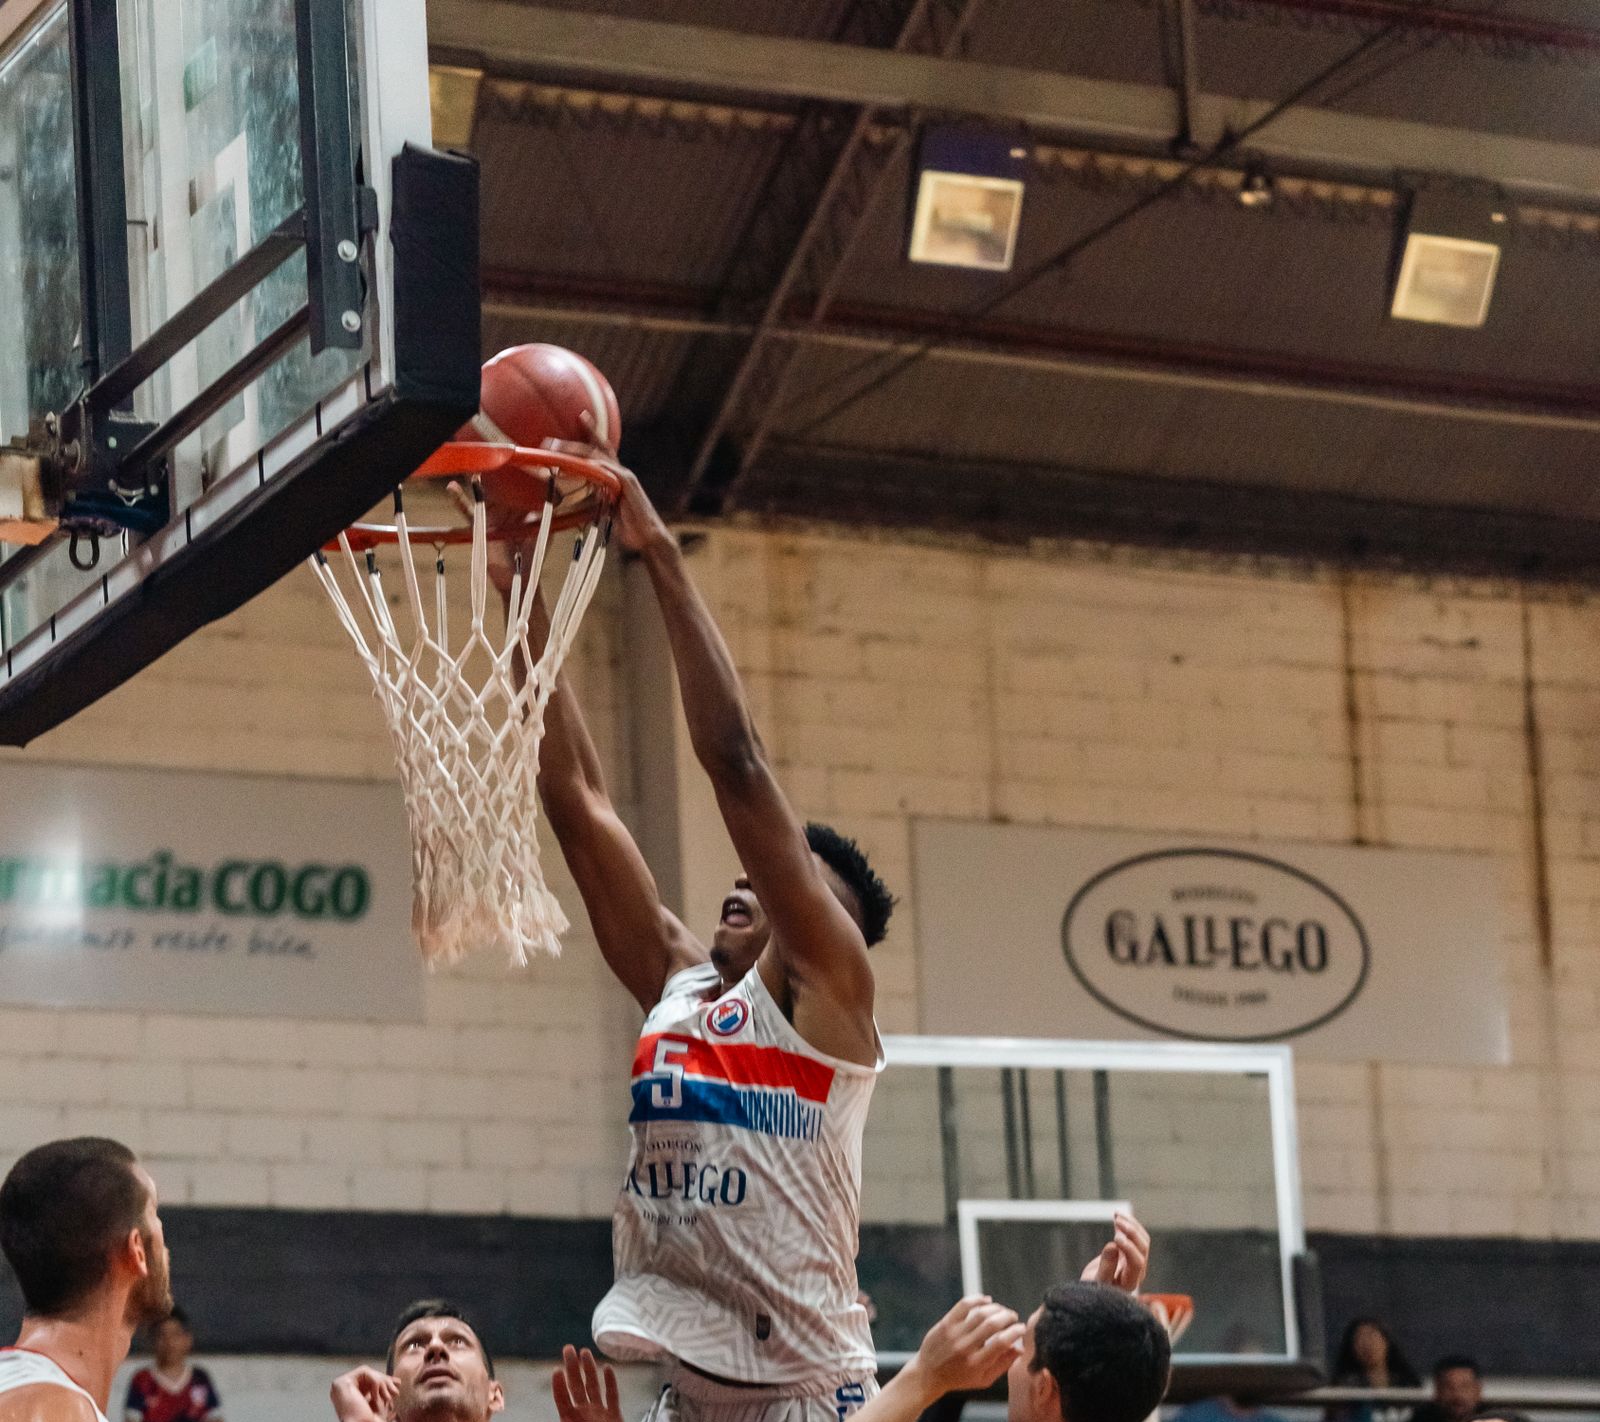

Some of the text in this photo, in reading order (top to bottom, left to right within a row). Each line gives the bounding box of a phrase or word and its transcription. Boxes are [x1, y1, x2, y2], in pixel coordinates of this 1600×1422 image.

[212, 857, 371, 922] COGO
[1104, 908, 1328, 974] GALLEGO
[651, 1039, 688, 1108] 5
